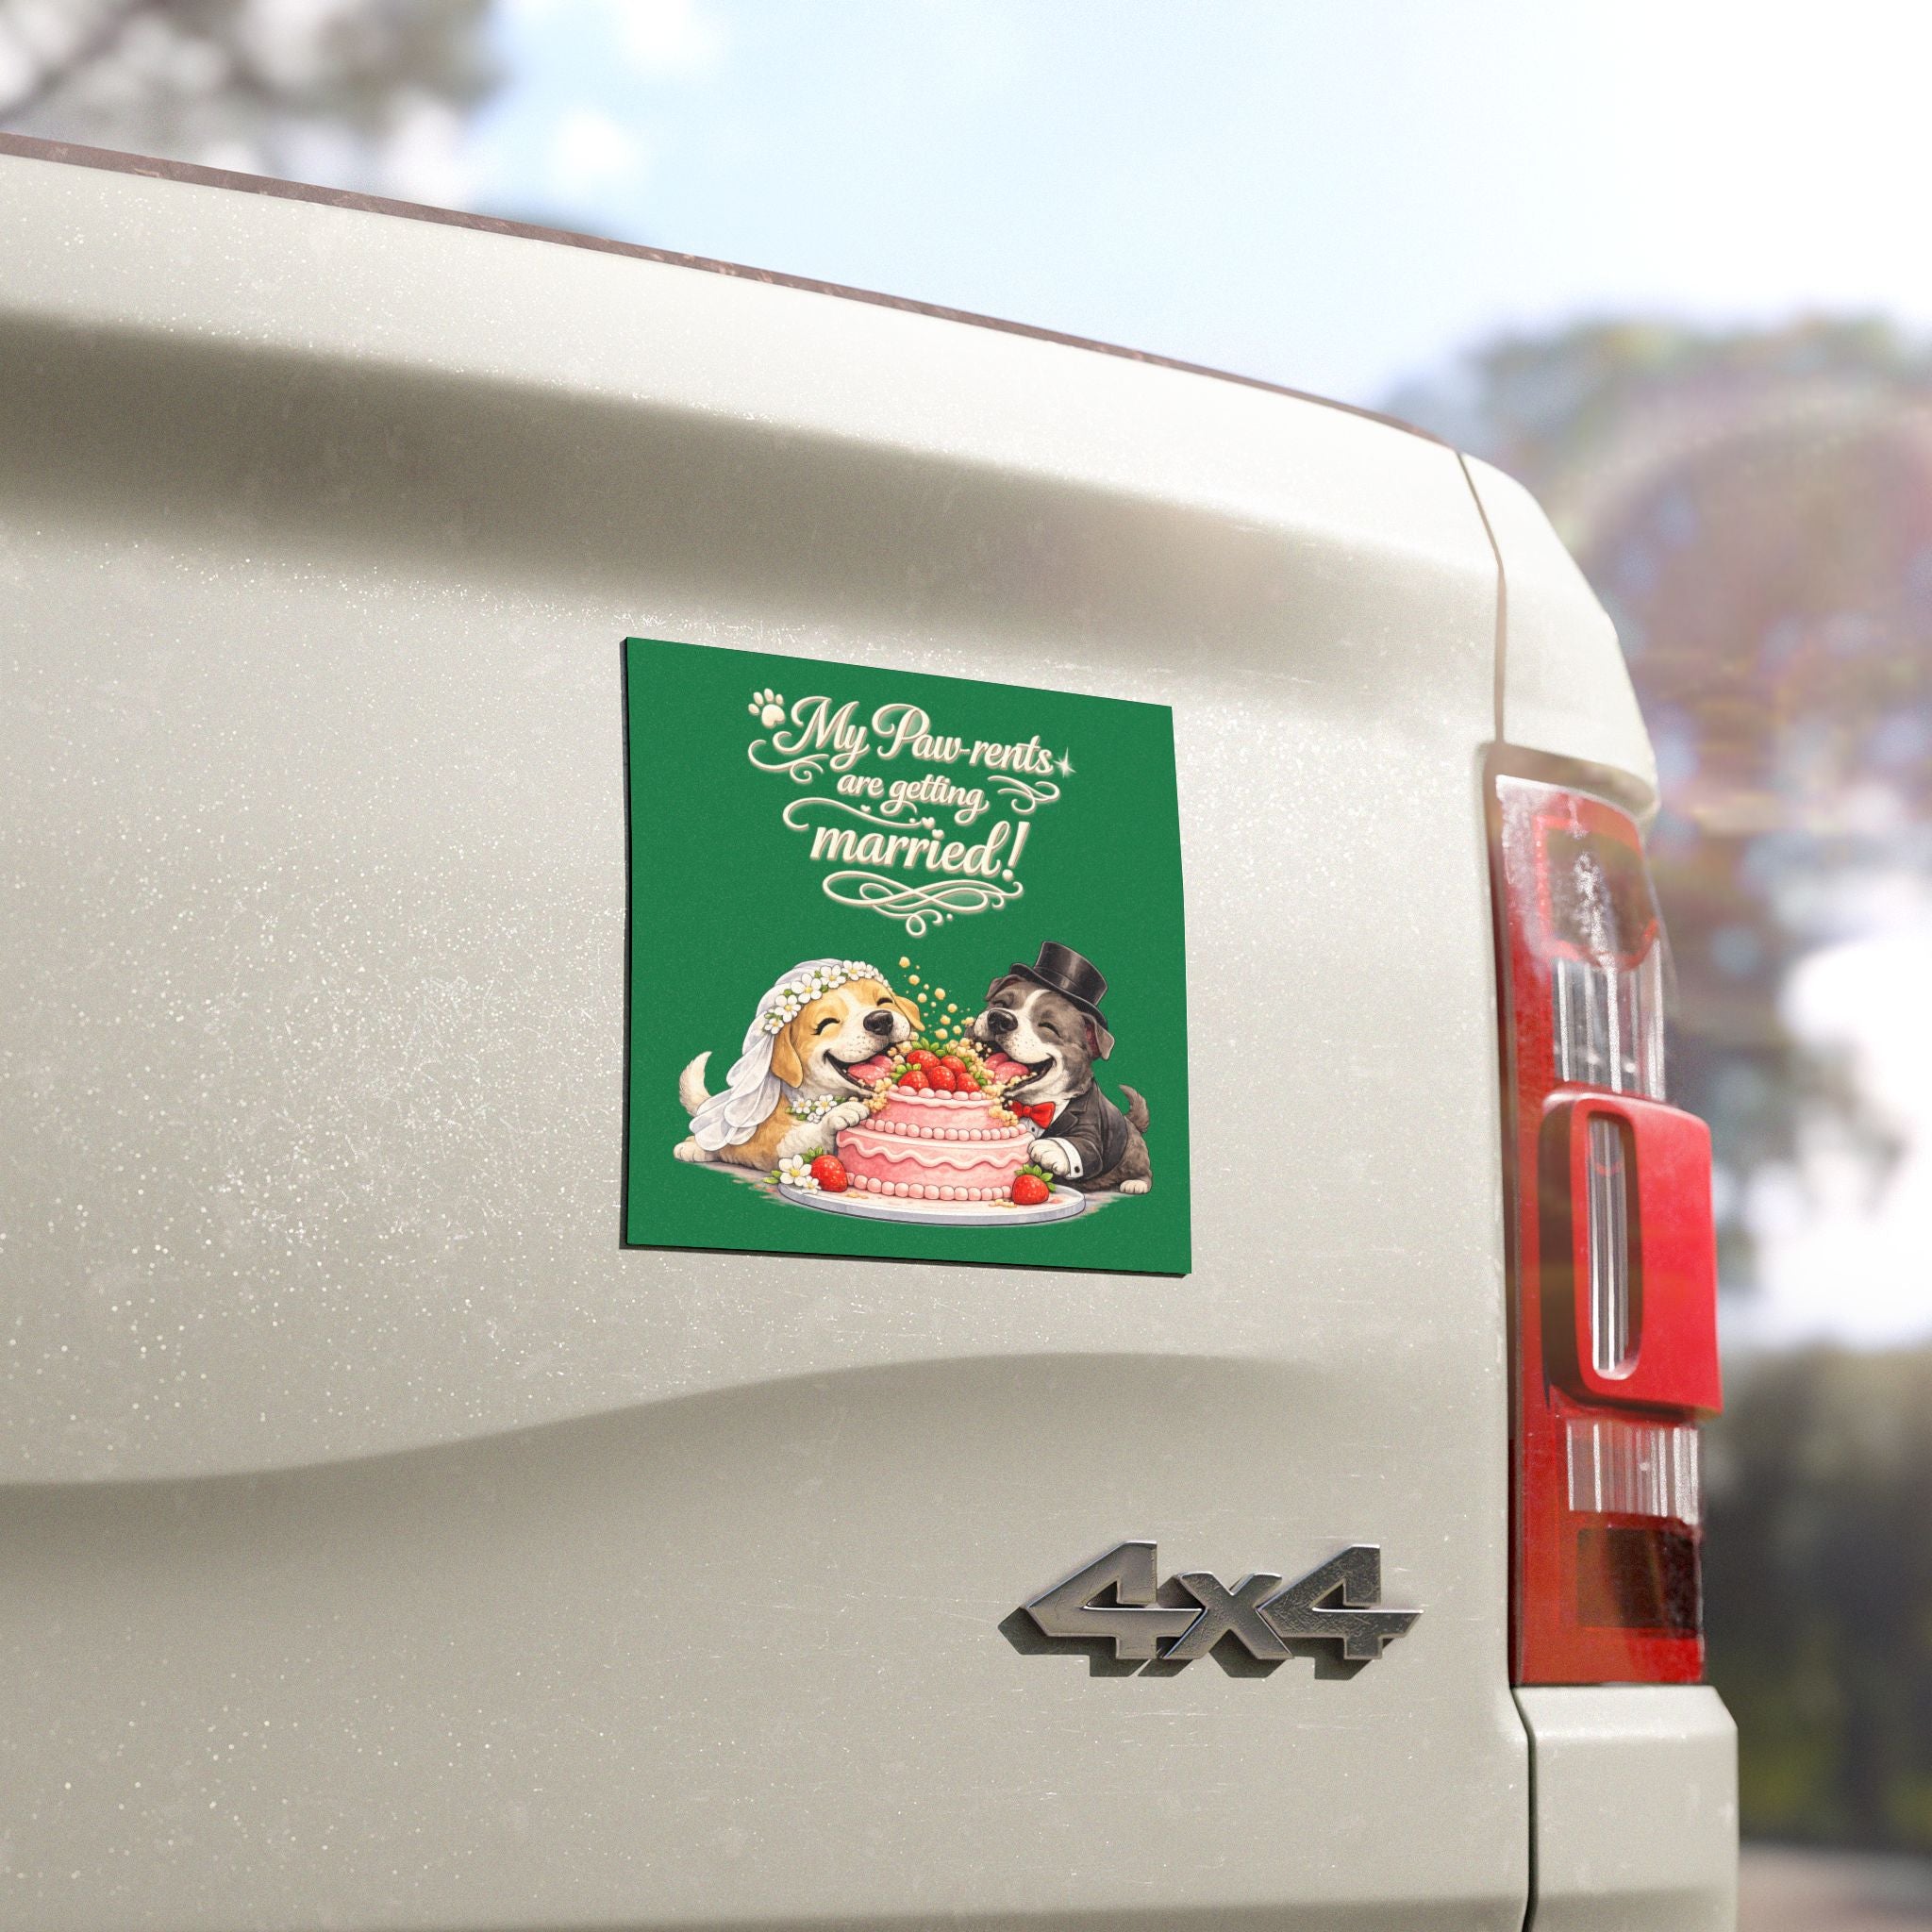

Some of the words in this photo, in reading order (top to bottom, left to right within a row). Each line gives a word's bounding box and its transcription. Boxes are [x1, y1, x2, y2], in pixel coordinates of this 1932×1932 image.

[772, 695, 871, 772] My
[871, 703, 1055, 775] Paw-rents
[836, 773, 885, 798] are
[879, 774, 991, 826] getting
[809, 821, 1031, 882] married!
